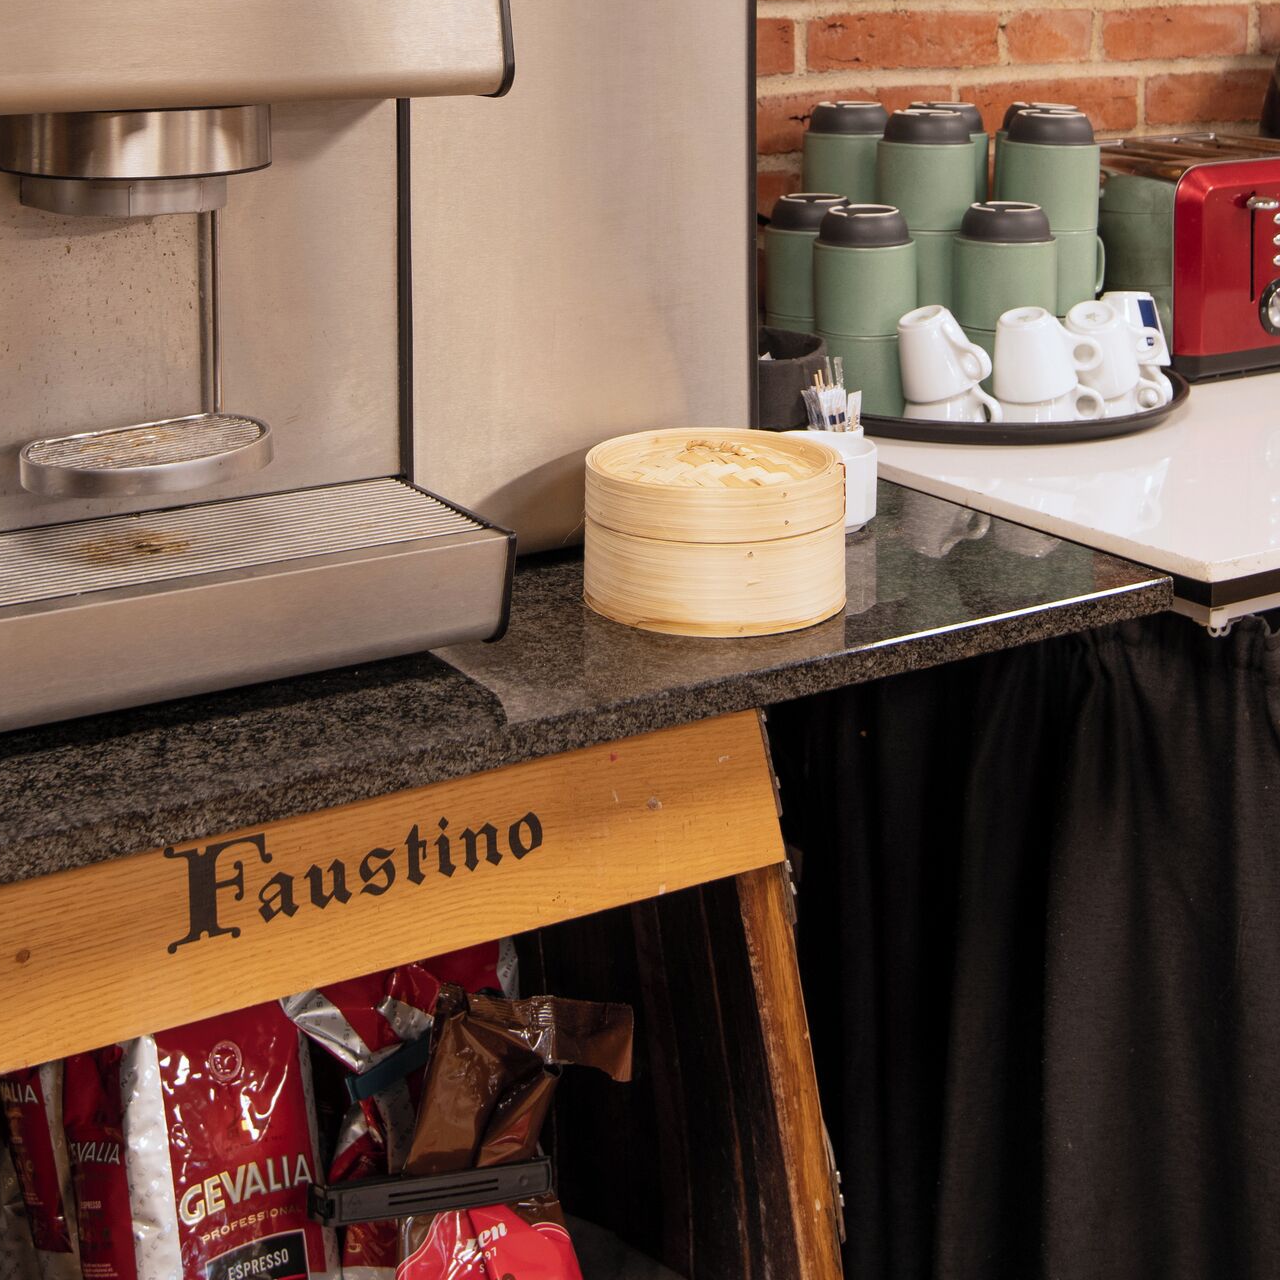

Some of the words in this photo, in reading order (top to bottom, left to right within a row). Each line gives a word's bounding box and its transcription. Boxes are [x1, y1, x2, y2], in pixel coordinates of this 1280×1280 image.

[163, 811, 543, 955] Faustino
[179, 1154, 313, 1226] GEVALIA
[201, 1204, 303, 1245] PROFESSIONAL
[227, 1248, 290, 1280] ESPRESSO
